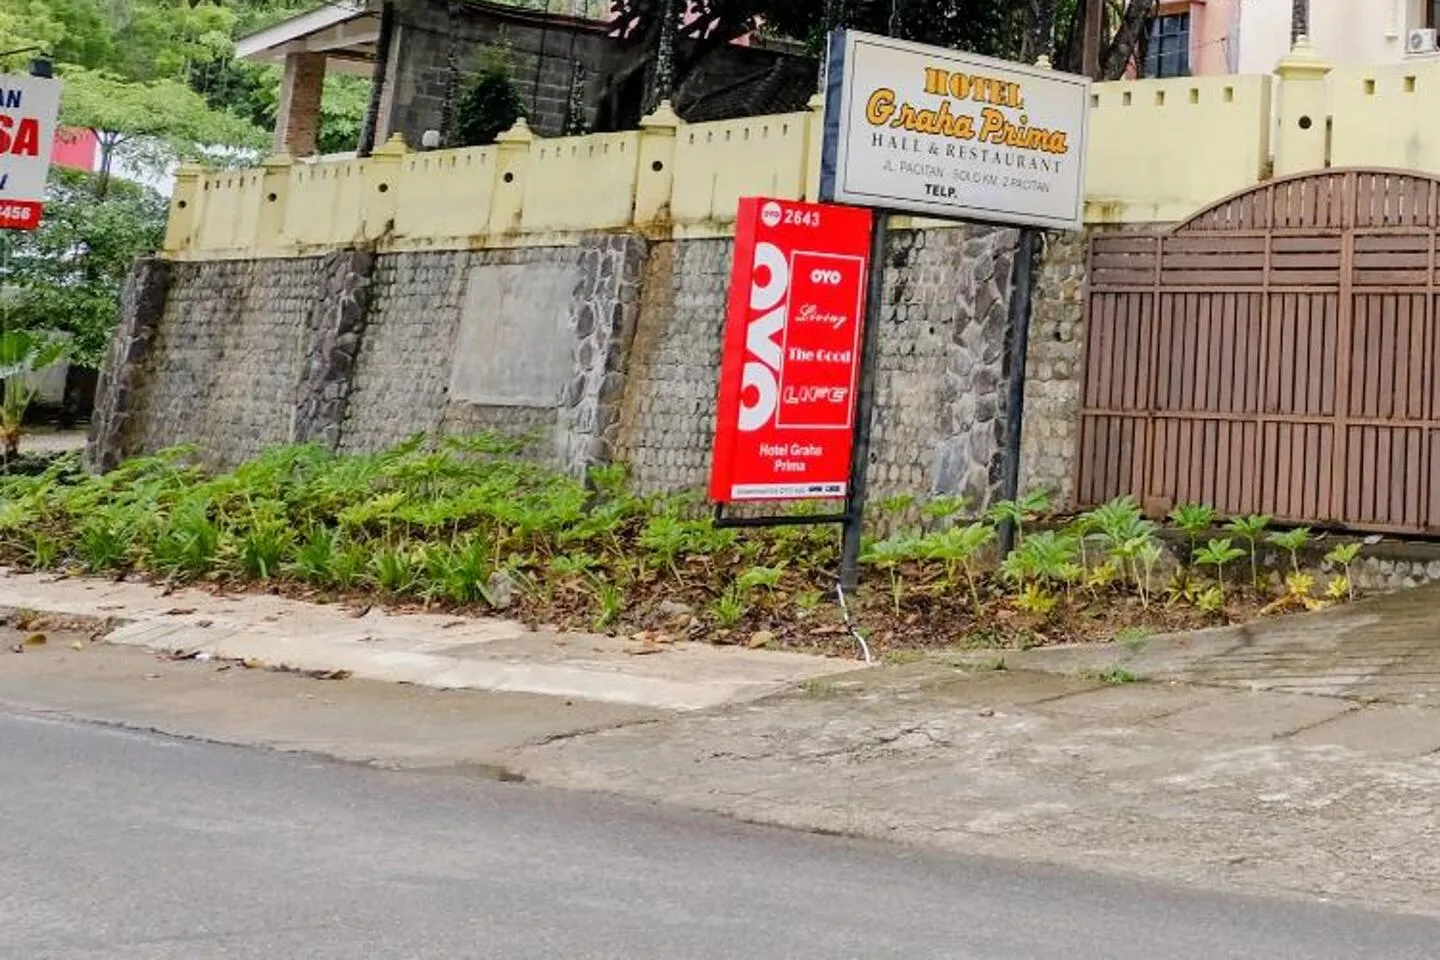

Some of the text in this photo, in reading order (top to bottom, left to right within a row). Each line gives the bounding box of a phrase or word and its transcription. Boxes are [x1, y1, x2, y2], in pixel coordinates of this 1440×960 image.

[923, 67, 1024, 109] HOTEL
[866, 88, 1069, 154] Graha Prima
[871, 132, 1062, 173] HALL & RESTAURANT
[925, 183, 958, 199] TELP.
[784, 208, 820, 227] 2643
[810, 268, 842, 284] OYO
[795, 303, 848, 330] Living
[738, 242, 788, 431] OYO
[789, 347, 851, 363] The Good
[759, 442, 823, 456] Hotel Graha
[774, 459, 806, 472] Prima
